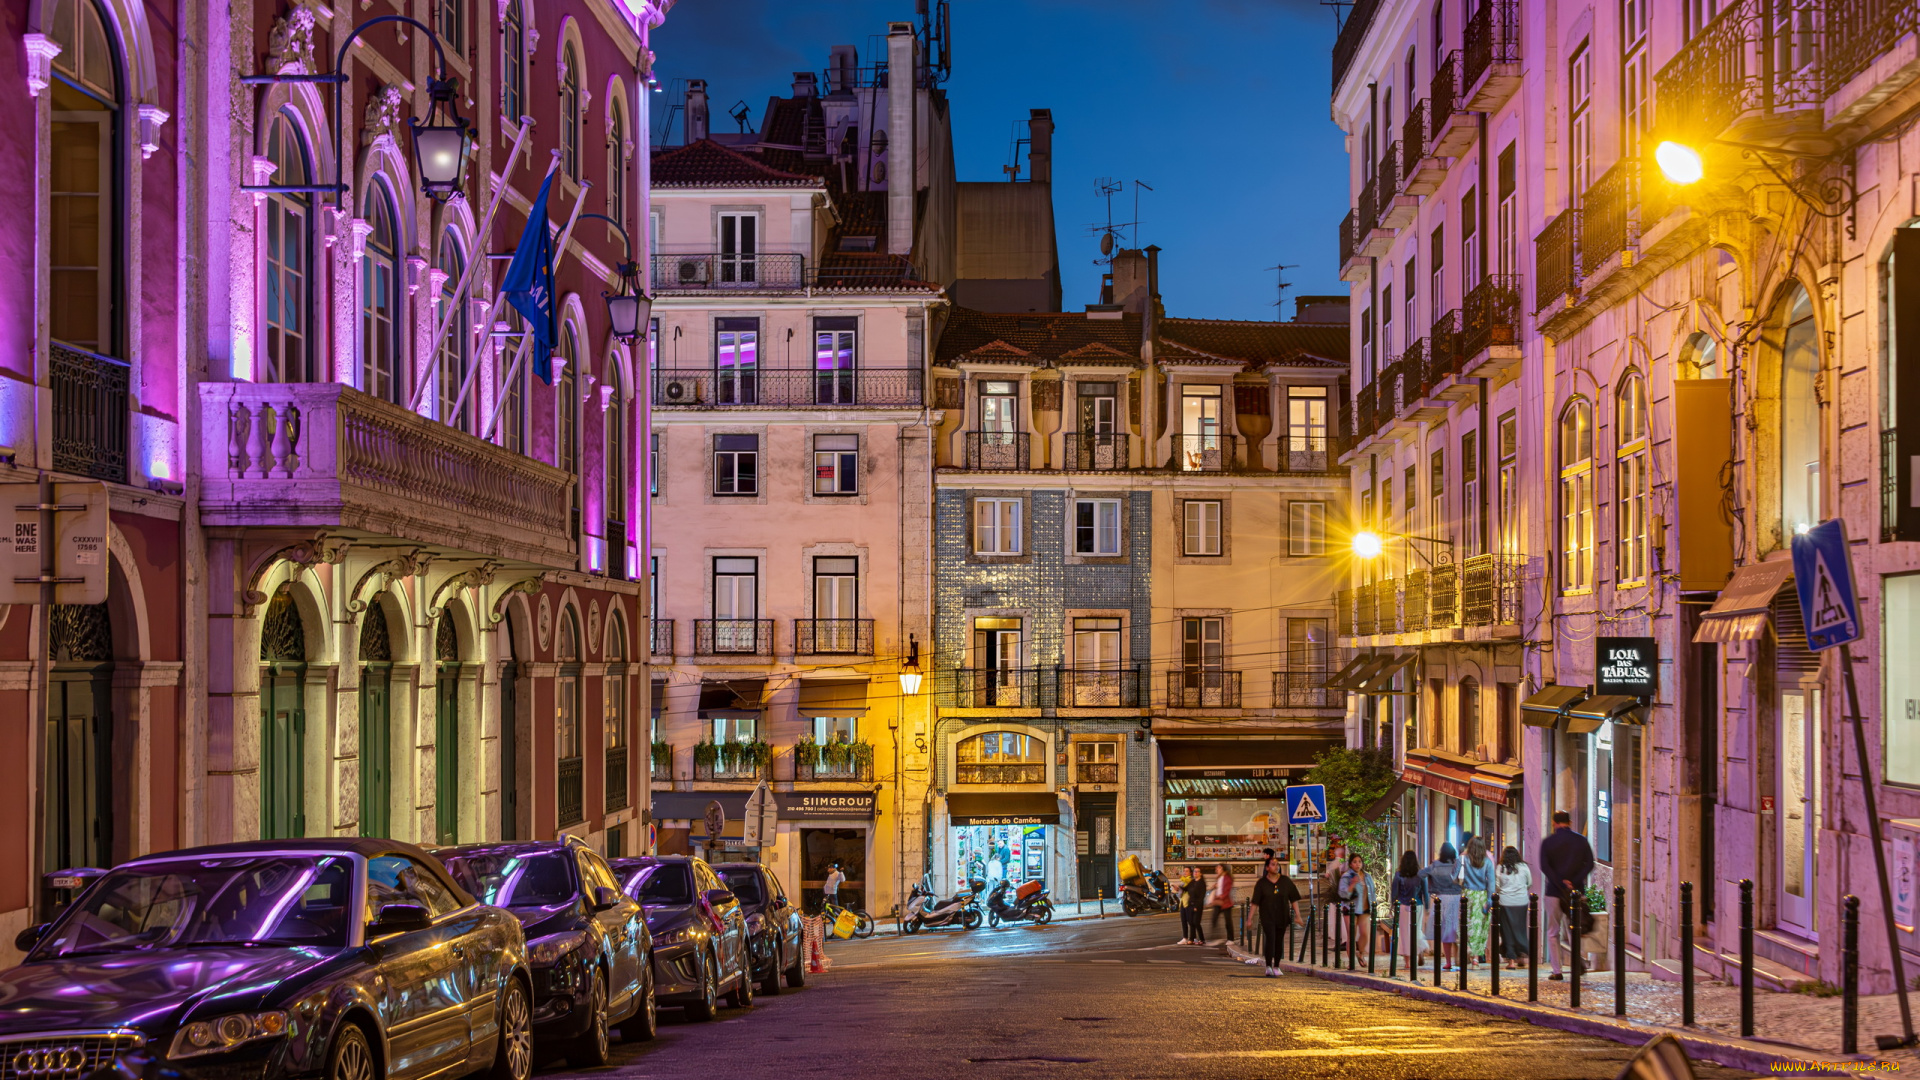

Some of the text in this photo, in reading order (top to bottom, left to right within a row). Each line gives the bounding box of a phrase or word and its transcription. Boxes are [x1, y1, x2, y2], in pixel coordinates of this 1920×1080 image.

[15, 523, 37, 536] BNE
[1609, 649, 1639, 660] LOJA
[803, 798, 872, 806] SIIMGROUP
